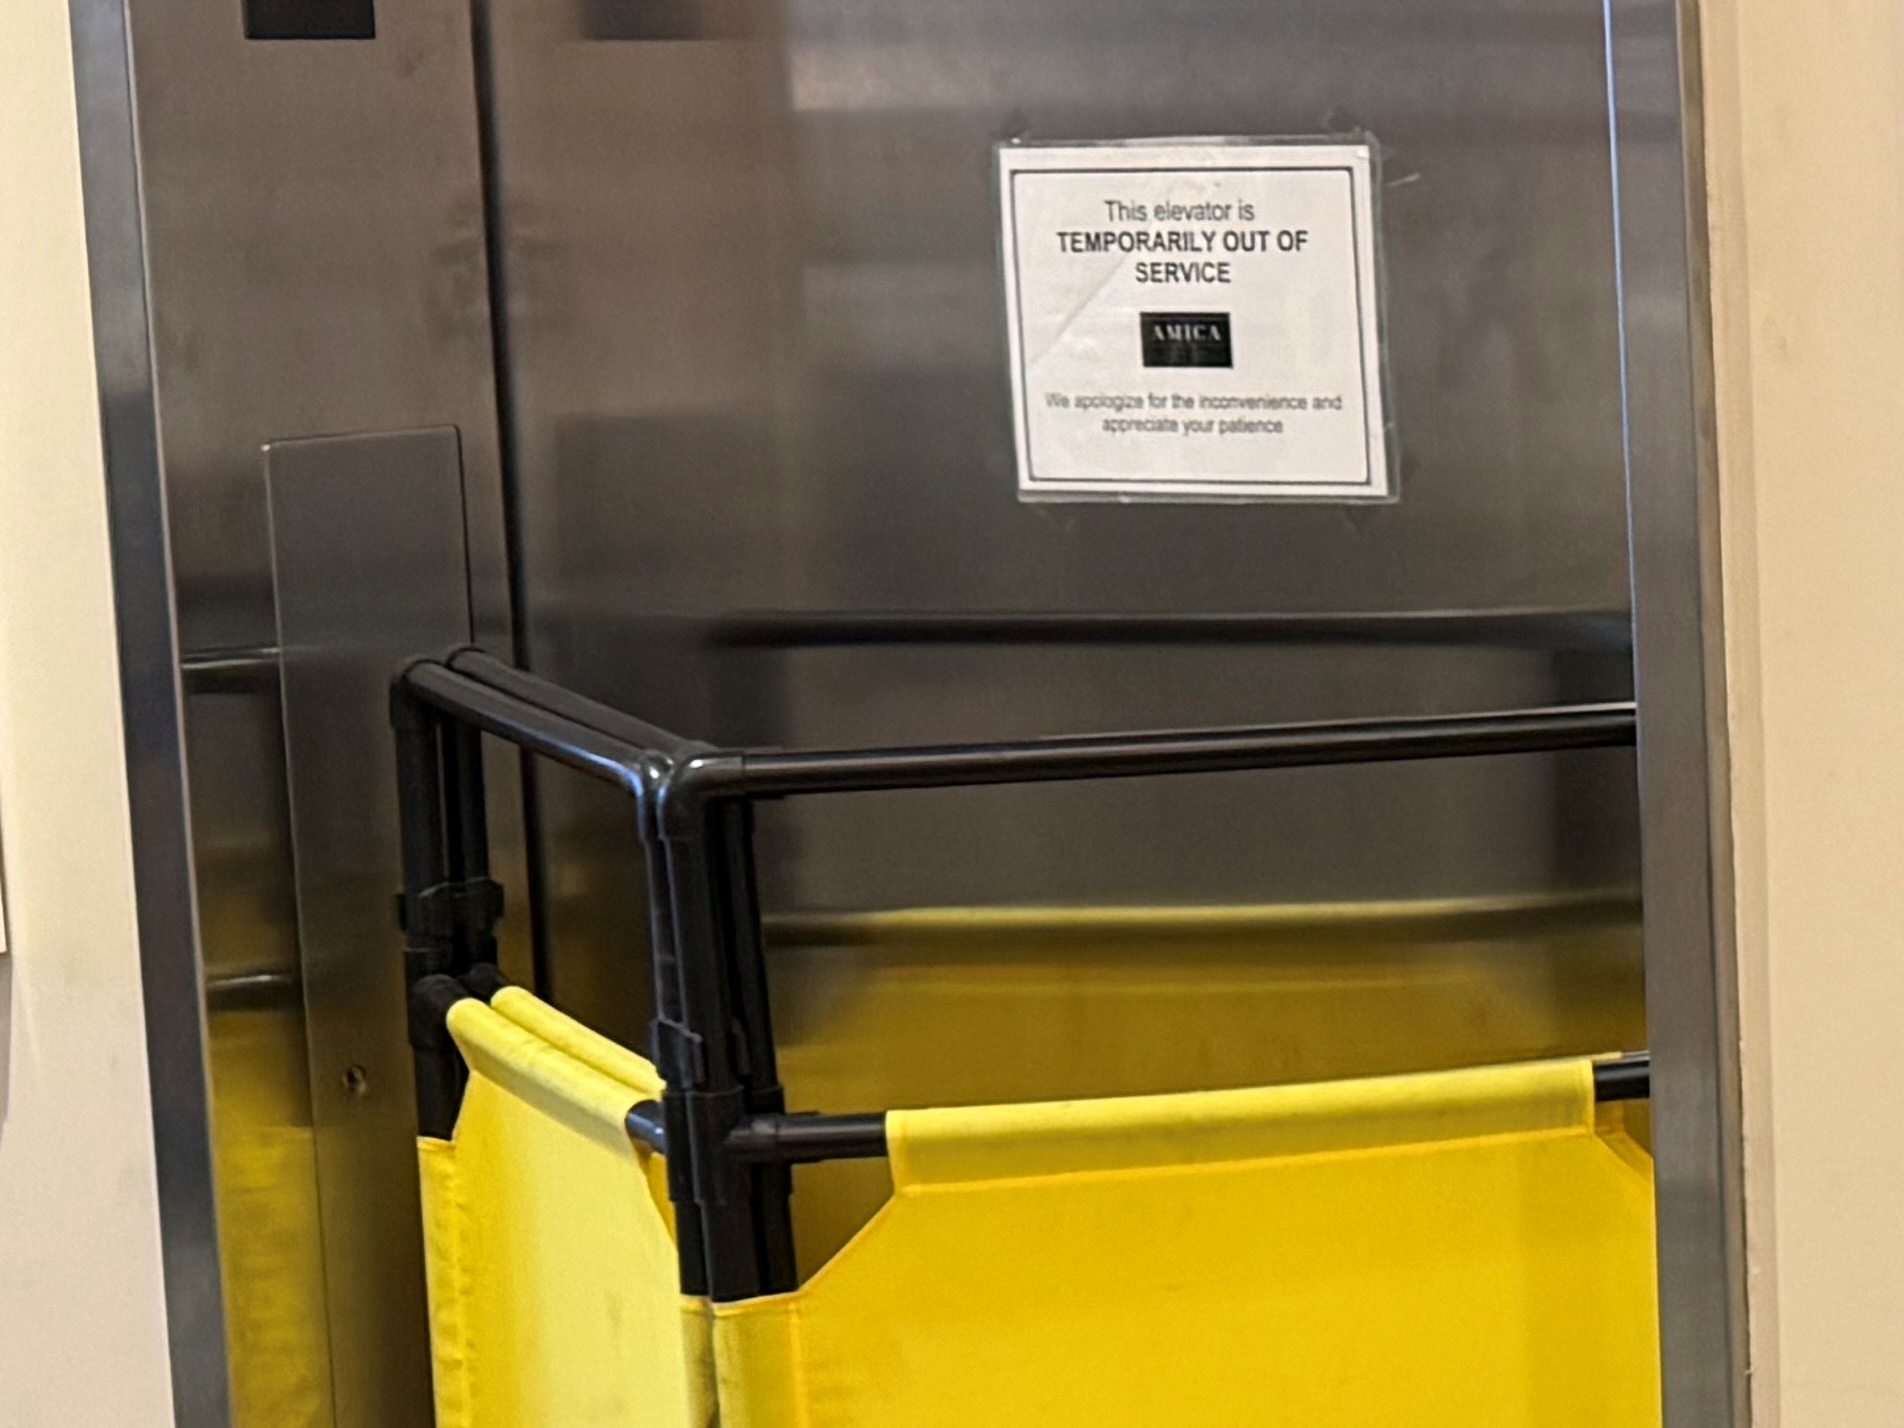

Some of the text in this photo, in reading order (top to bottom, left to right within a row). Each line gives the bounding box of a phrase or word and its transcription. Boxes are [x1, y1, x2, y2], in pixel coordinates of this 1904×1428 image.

[1104, 198, 1256, 222] This elevator is
[1056, 229, 1309, 253] TEMPORARILY OUT OF
[1135, 261, 1232, 284] SERVICE
[1152, 323, 1222, 341] AMICA
[1045, 392, 1344, 413] We apologize for the inconvenience and
[1102, 417, 1284, 436] appreciate your patience
